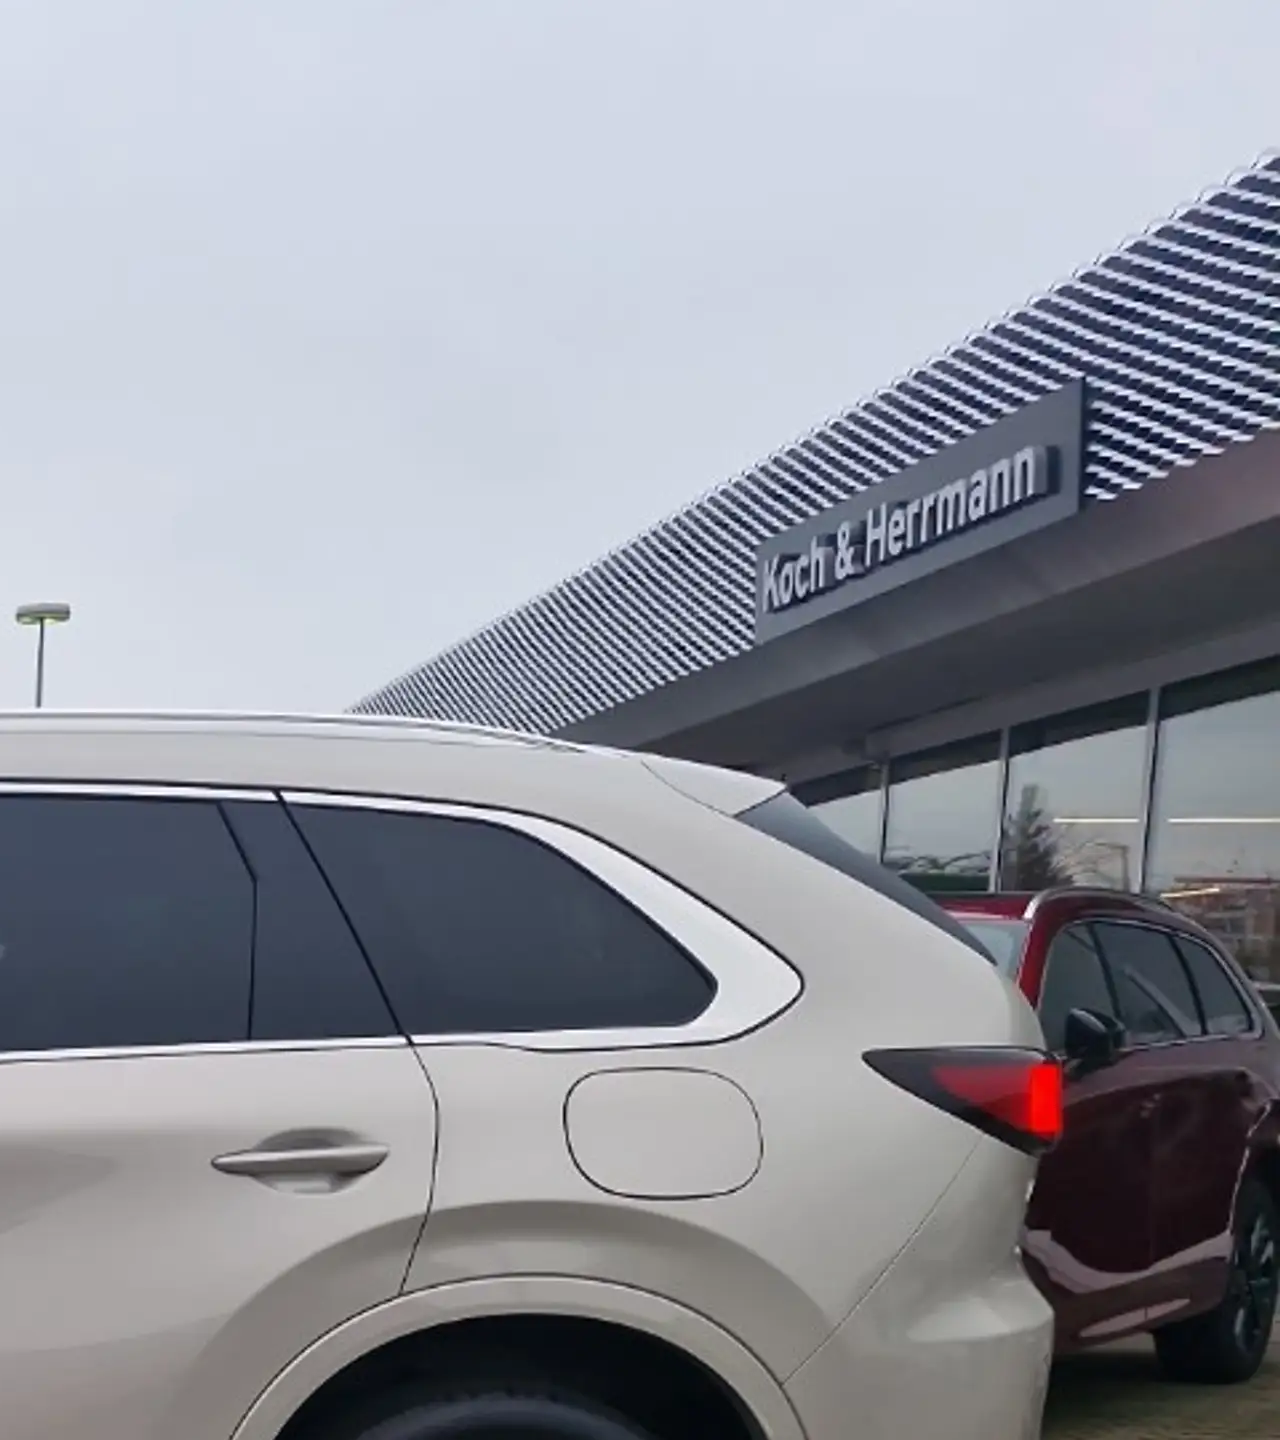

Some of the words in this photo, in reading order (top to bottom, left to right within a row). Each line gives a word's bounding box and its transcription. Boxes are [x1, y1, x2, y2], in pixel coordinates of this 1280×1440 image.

[762, 535, 826, 612] Koch
[834, 520, 856, 581] &
[864, 445, 1038, 568] Herrmann
